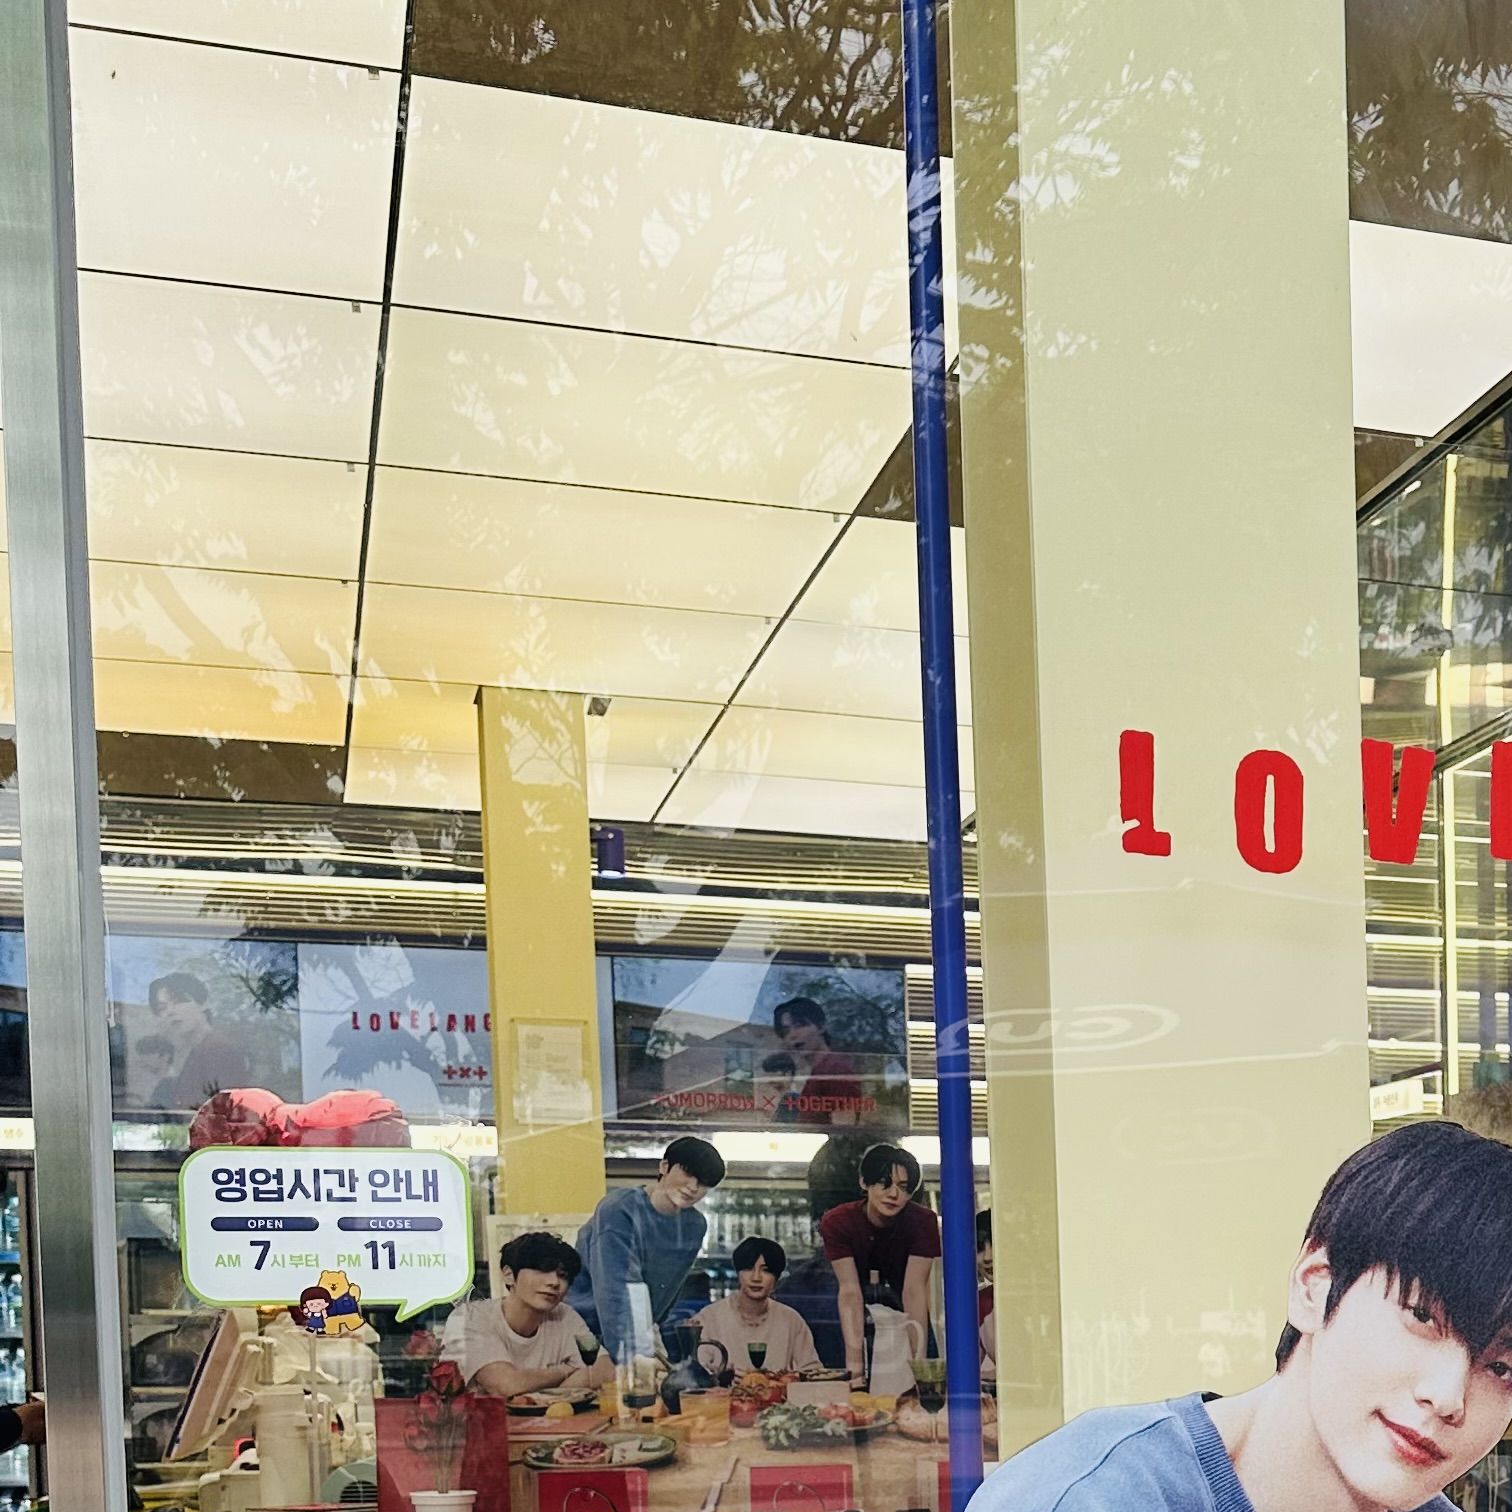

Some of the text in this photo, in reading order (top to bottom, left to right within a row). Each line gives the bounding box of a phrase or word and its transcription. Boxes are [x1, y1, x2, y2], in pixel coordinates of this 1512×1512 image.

[211, 1167, 440, 1203] 영업시간 안내
[247, 1219, 284, 1229] OPEN
[369, 1219, 412, 1230] CLOSE
[215, 1254, 241, 1268] AM
[336, 1254, 361, 1268] PM
